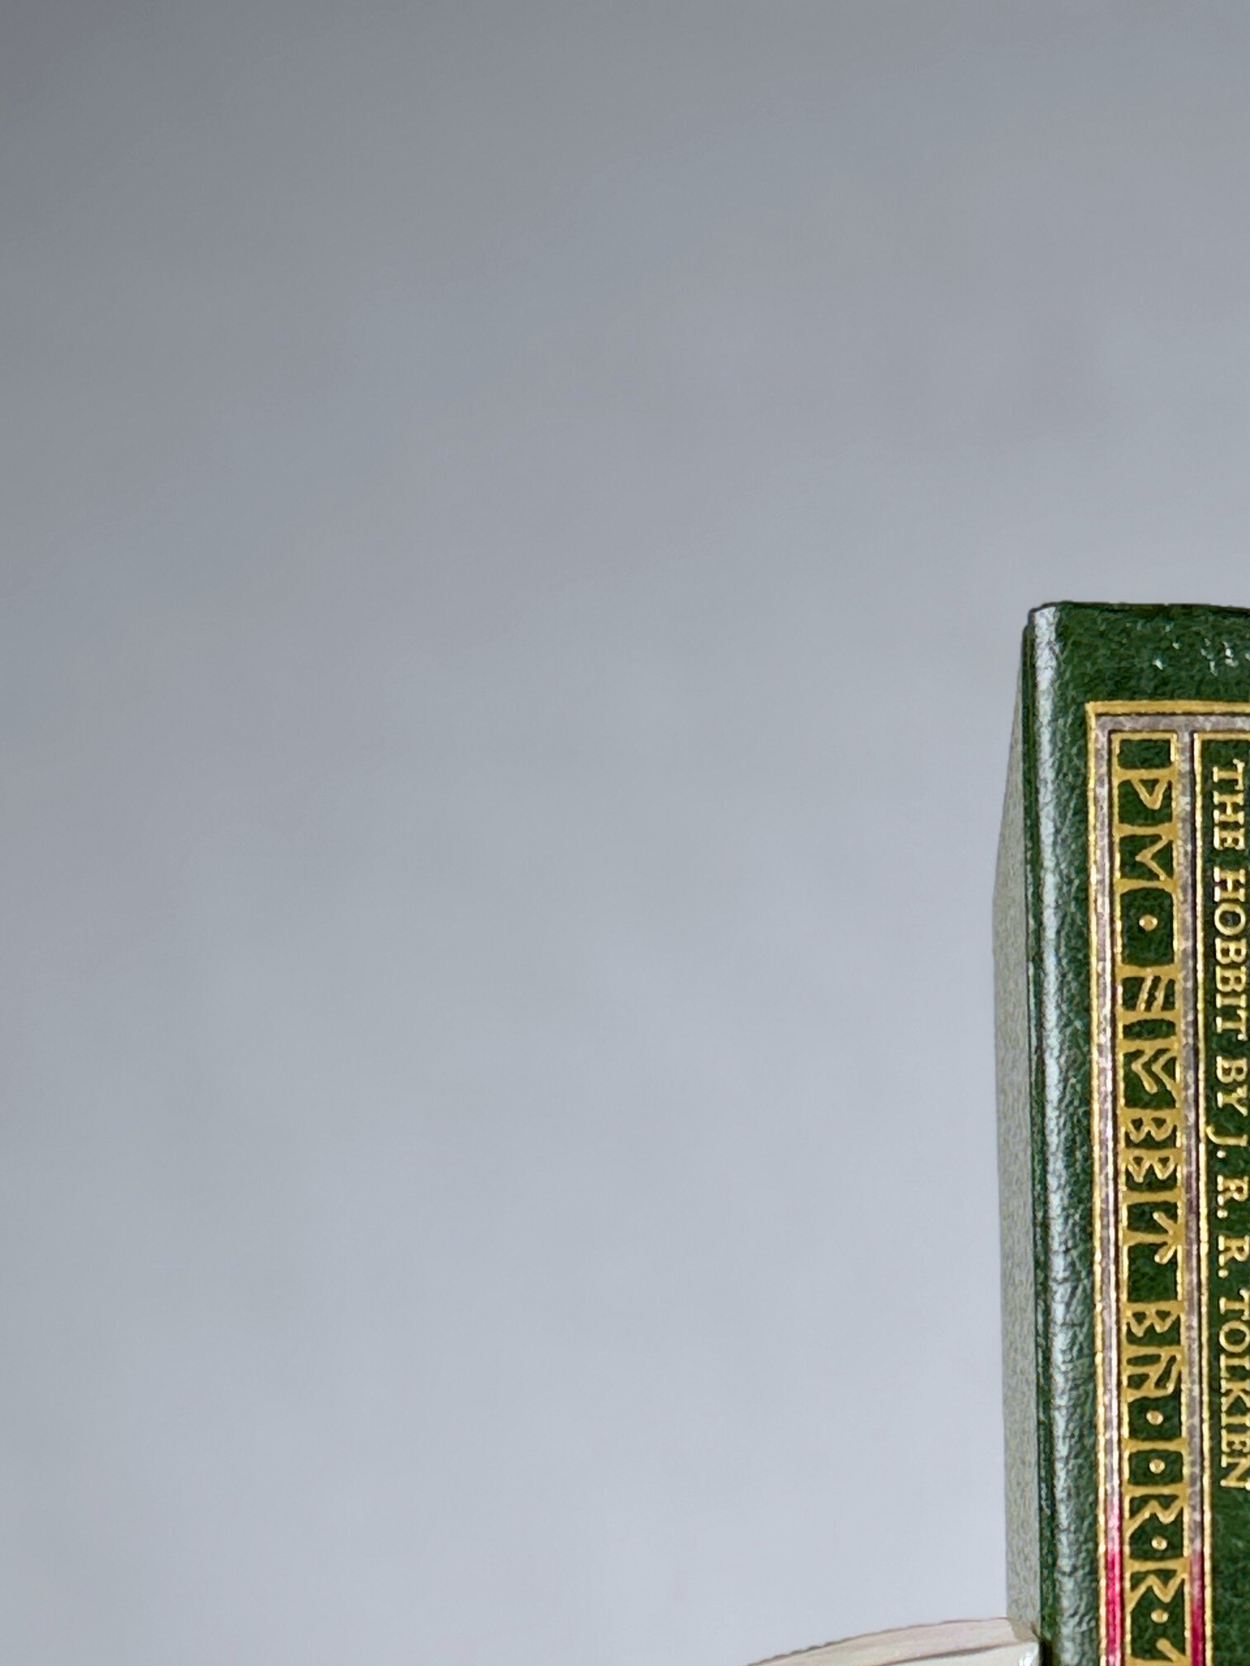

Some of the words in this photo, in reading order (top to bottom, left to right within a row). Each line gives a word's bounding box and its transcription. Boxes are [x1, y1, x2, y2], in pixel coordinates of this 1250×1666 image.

[1211, 759, 1246, 851] THE
[1212, 866, 1248, 1041] HOBBIT
[1215, 1056, 1249, 1117] BY
[1206, 1125, 1249, 1159] J.
[1216, 1174, 1250, 1219] R.
[1217, 1234, 1250, 1279] R.
